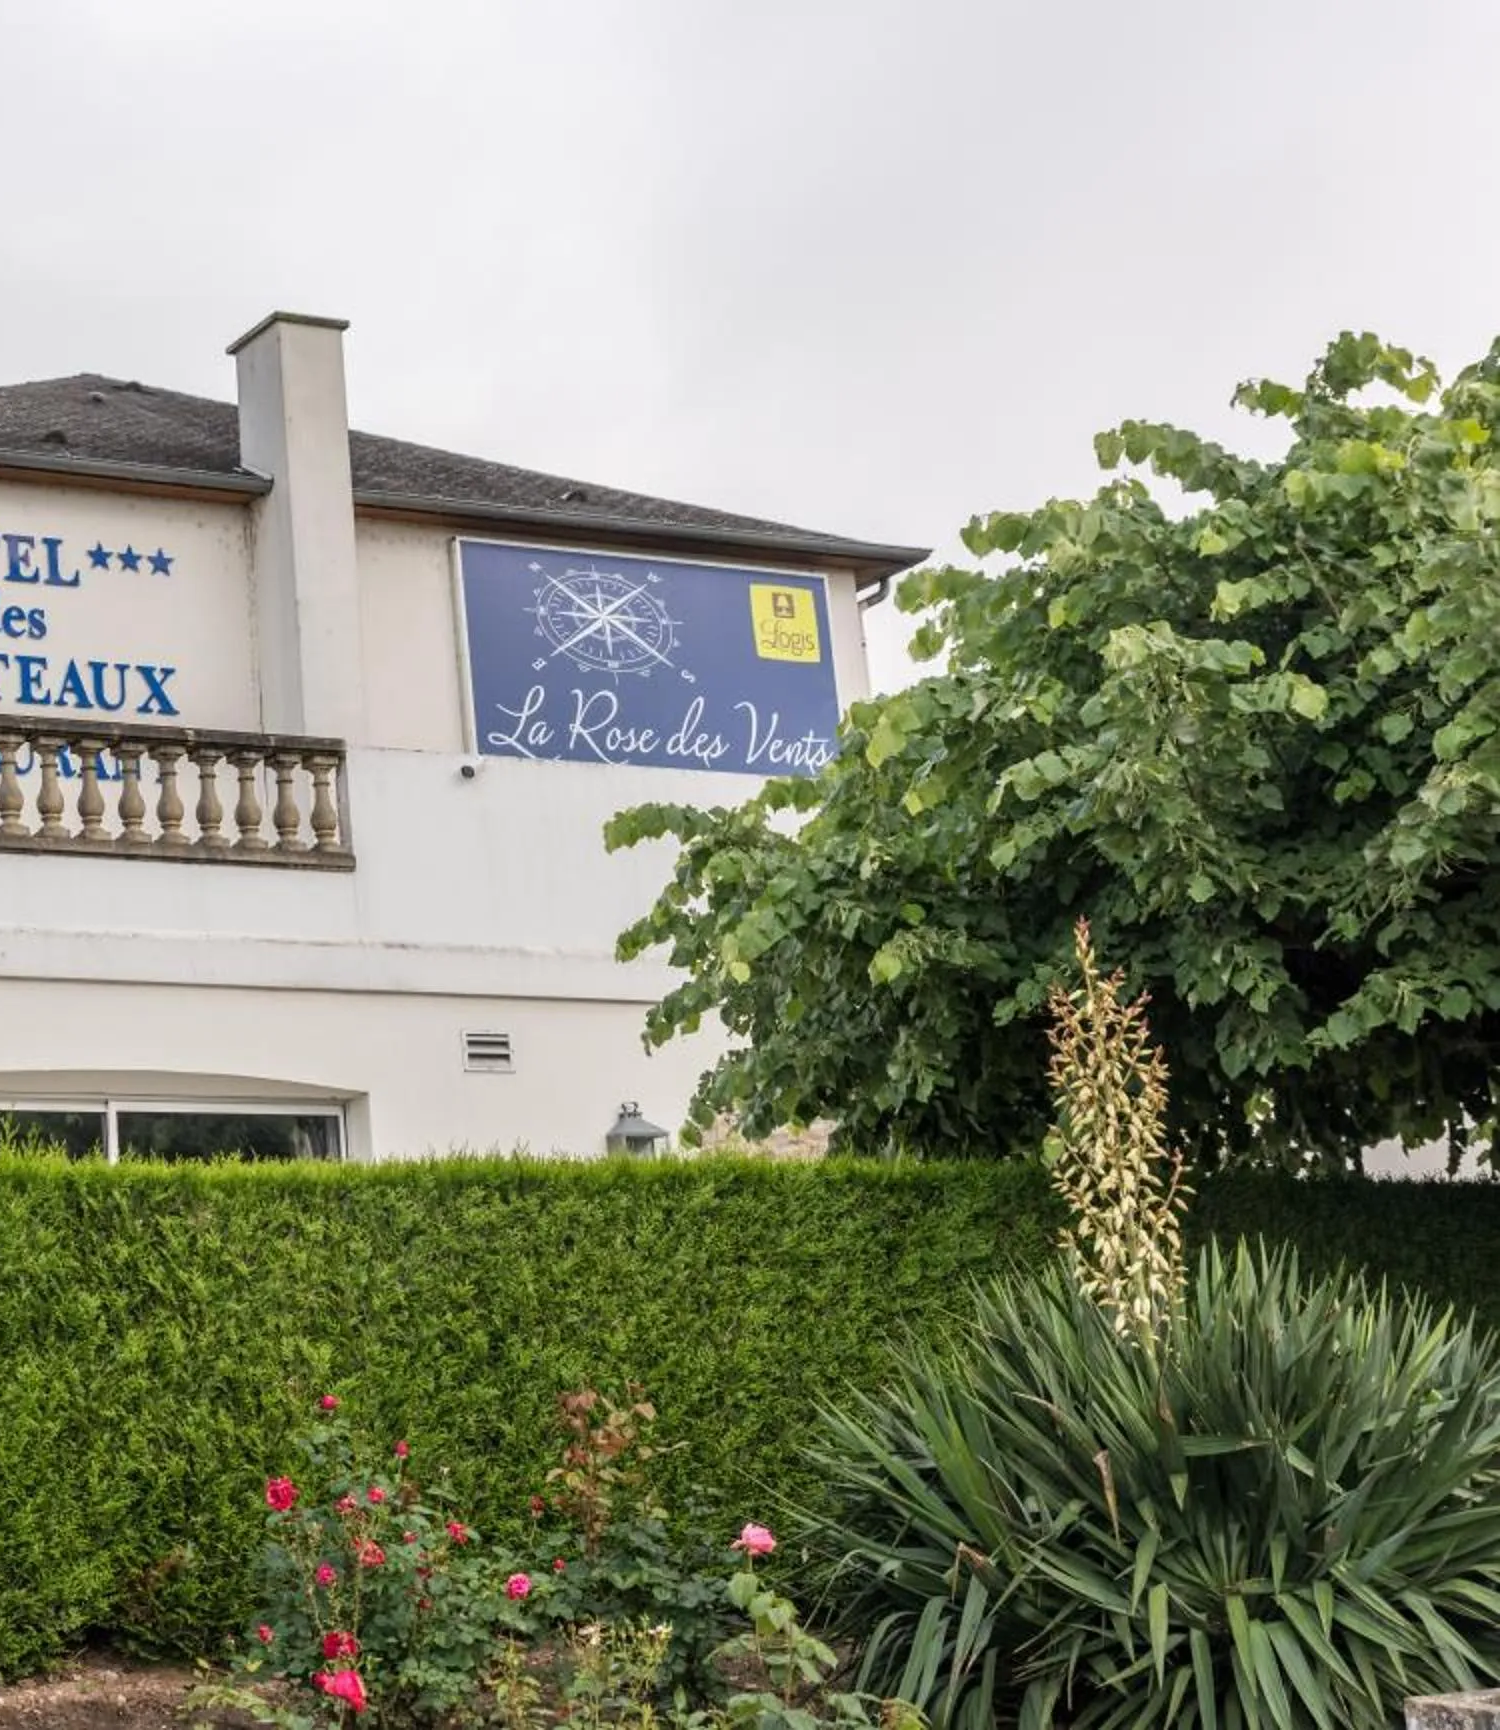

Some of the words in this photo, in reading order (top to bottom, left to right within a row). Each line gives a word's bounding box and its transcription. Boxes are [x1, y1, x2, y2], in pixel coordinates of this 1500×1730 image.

[760, 618, 816, 657] Logis
[488, 685, 560, 764] La
[569, 688, 661, 765] Rose
[666, 696, 730, 768] des
[733, 700, 835, 776] Vents
